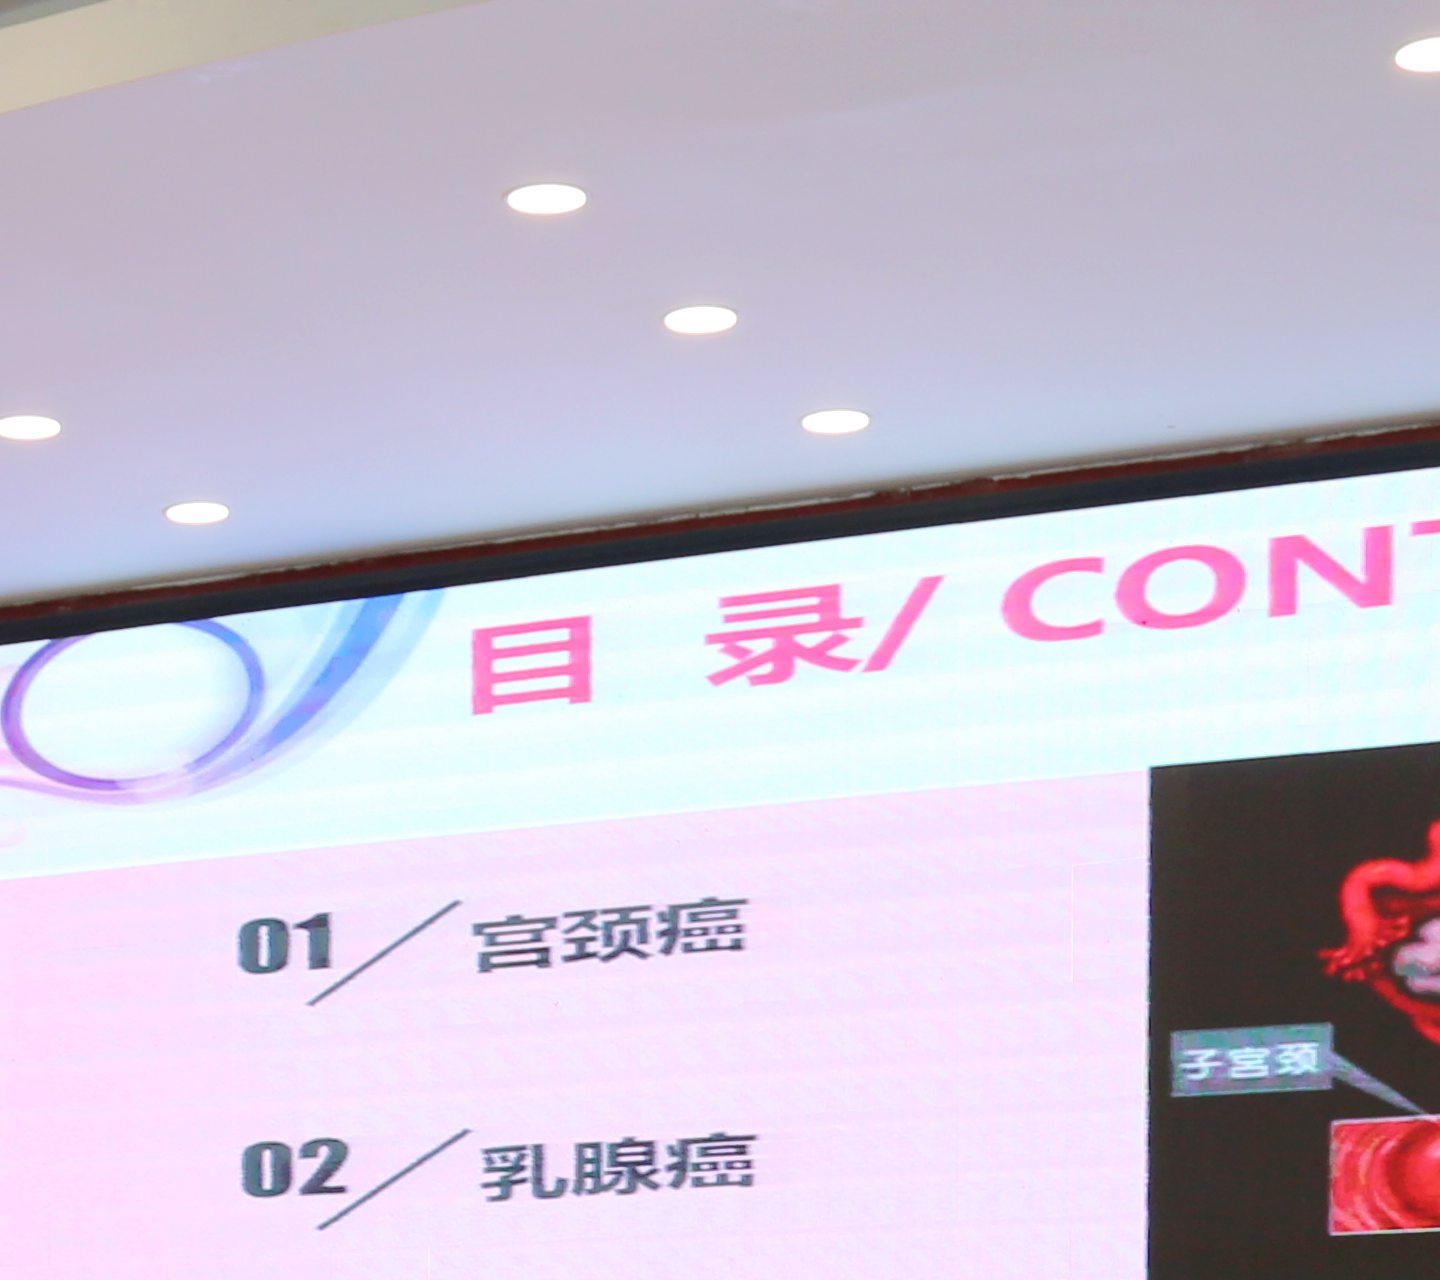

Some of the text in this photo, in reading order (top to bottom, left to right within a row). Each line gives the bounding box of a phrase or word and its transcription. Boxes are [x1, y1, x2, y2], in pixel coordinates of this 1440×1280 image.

[470, 615, 594, 716] 目
[237, 896, 749, 975] 01 宫颈癌
[241, 1131, 759, 1203] 02 乳腺癌
